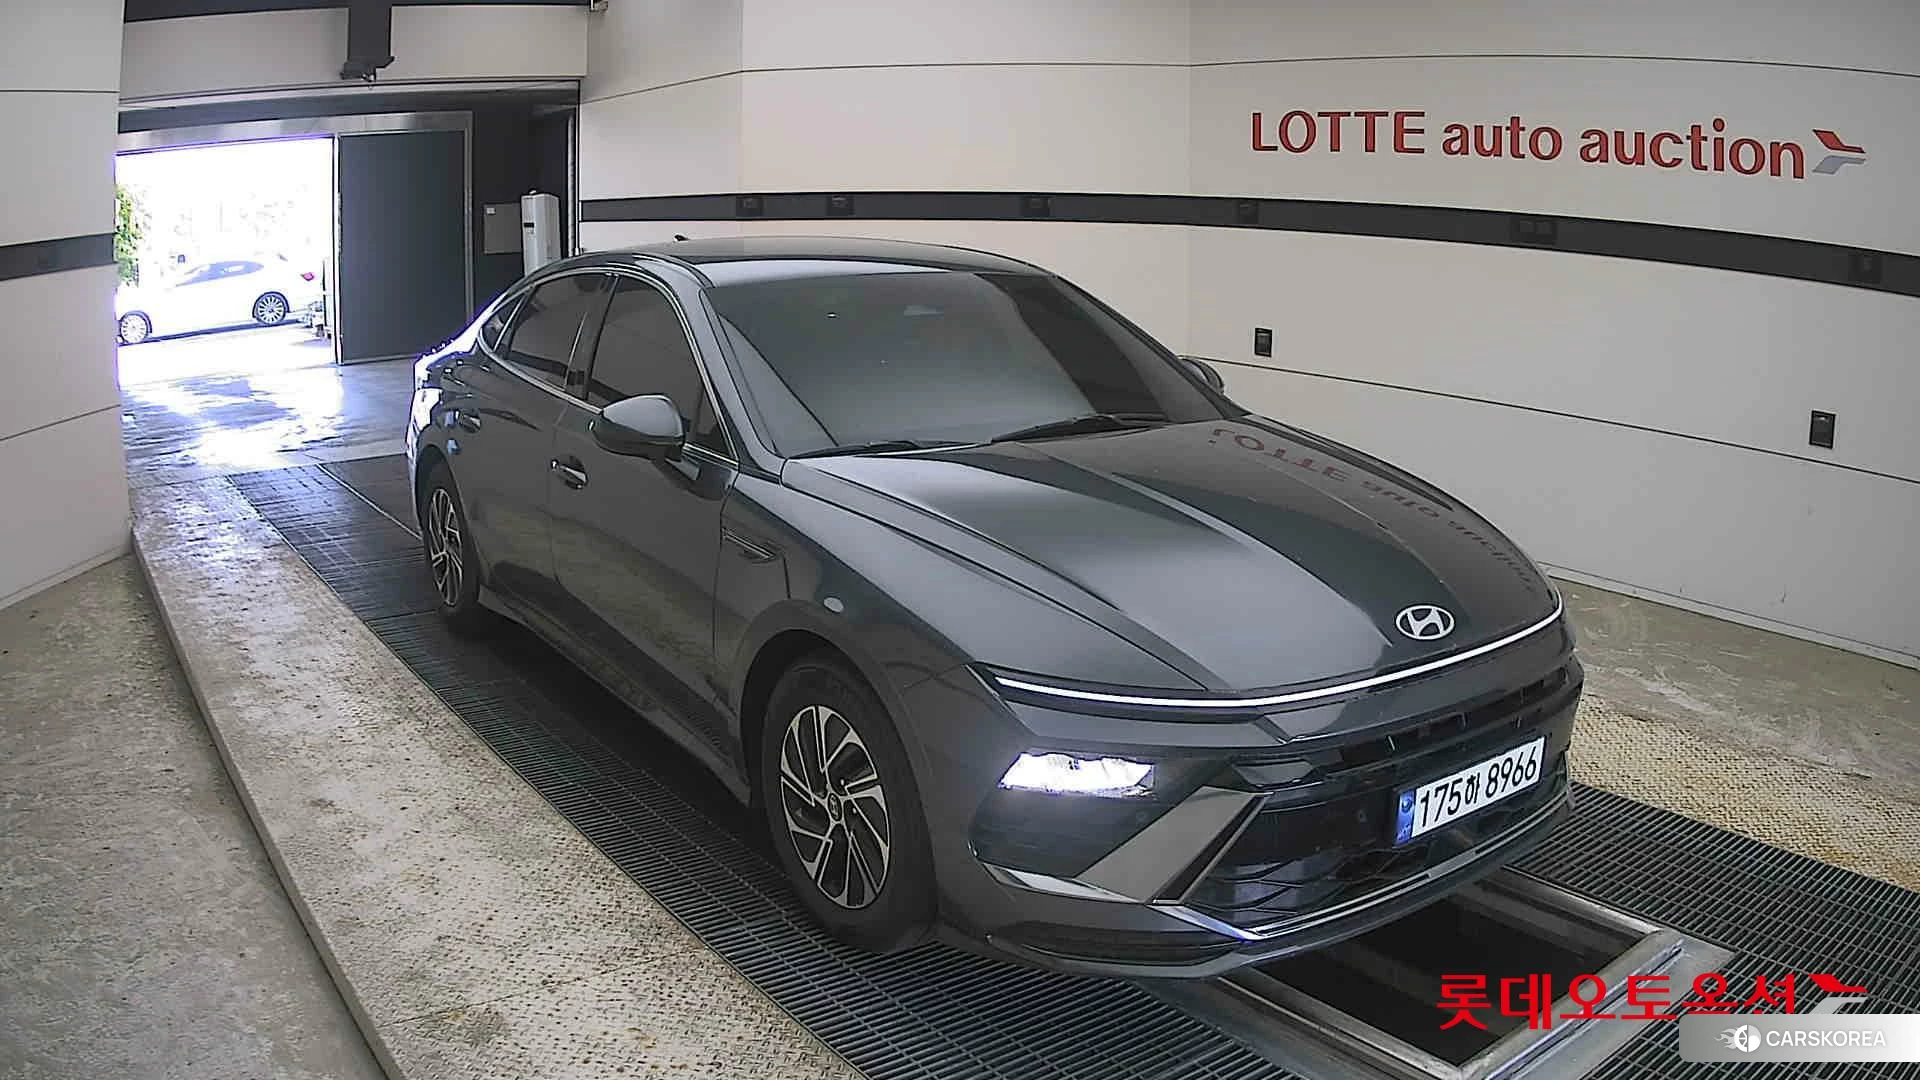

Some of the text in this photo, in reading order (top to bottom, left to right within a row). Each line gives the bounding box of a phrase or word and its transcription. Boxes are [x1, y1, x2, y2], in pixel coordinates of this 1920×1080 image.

[1252, 111, 1806, 179] LOTTE auto auction
[1420, 745, 1537, 827] 175하 8966
